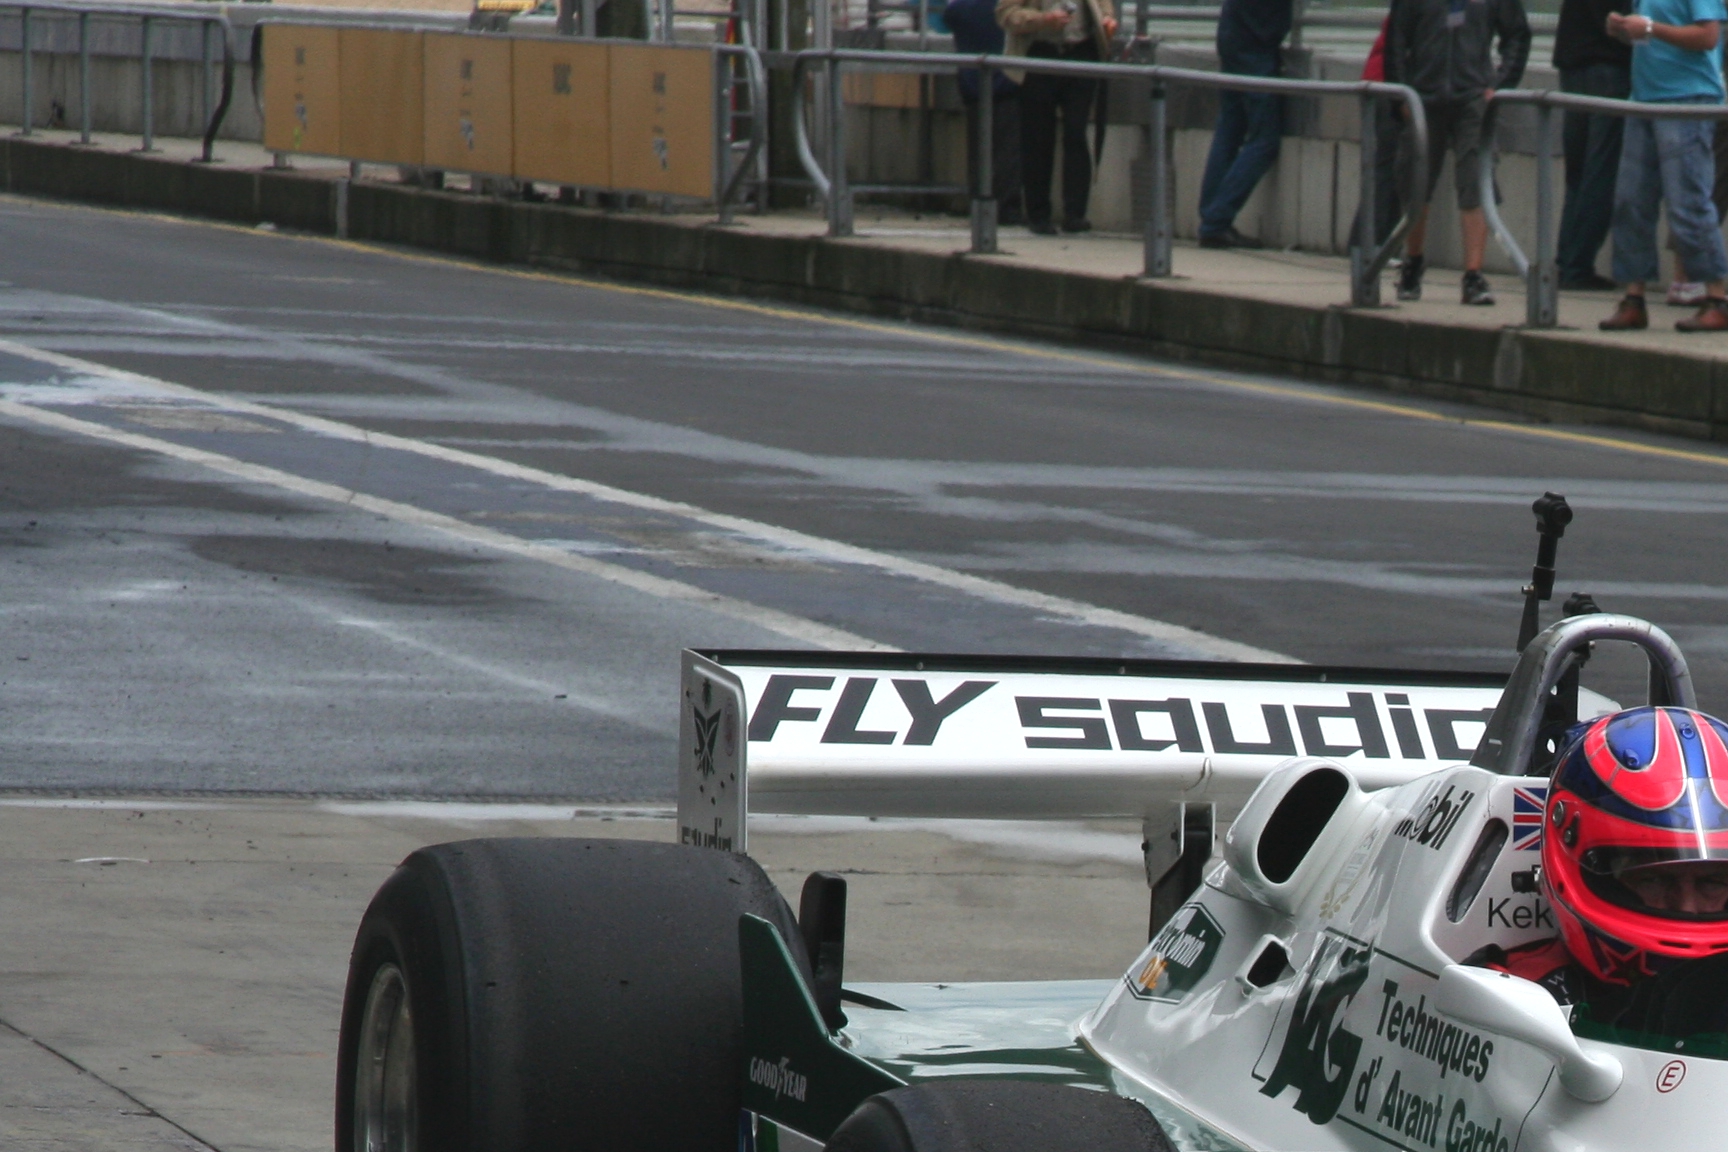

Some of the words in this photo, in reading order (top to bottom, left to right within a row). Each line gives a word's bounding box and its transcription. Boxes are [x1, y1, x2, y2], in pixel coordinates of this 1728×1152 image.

[747, 674, 1000, 746] FLY
[1014, 691, 1496, 760] saudia
[1488, 898, 1554, 928] Kek
[1376, 979, 1494, 1083] Techniques
[1376, 1069, 1444, 1149] Avant
